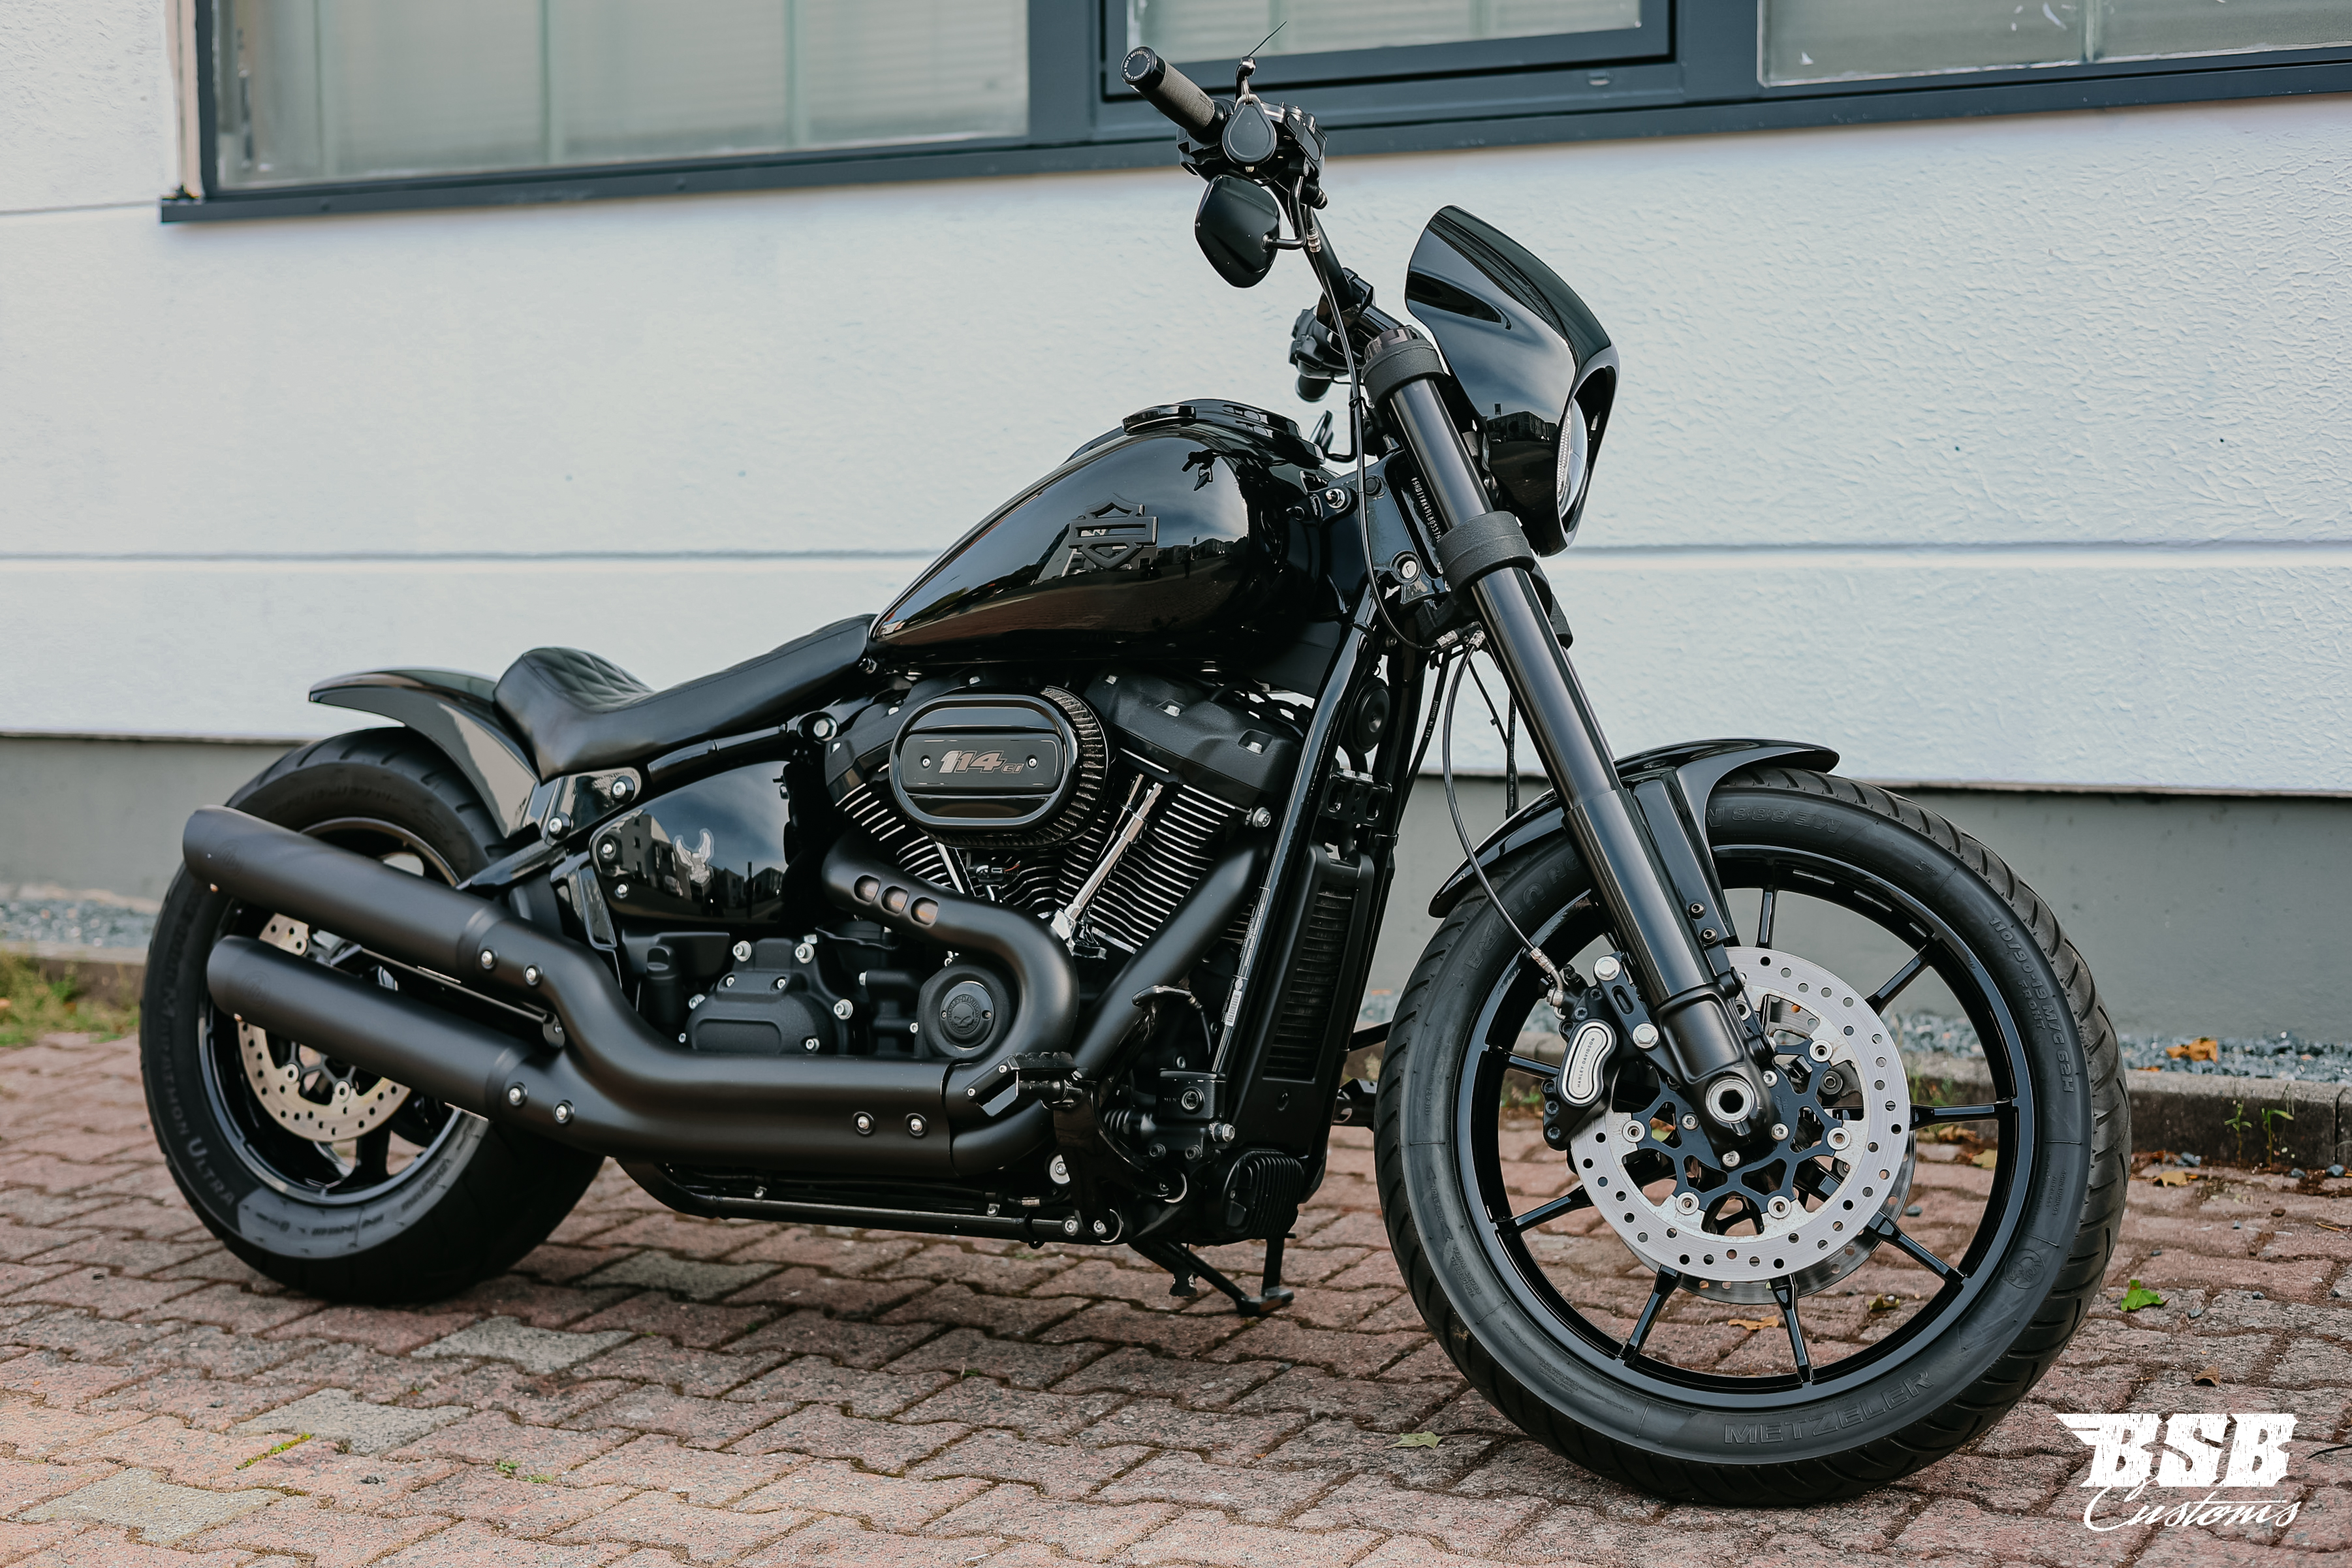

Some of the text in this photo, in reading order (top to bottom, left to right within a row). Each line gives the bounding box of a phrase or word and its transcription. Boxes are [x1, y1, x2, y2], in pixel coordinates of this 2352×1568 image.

[1989, 917, 2048, 1000] 110/90-19
[2056, 1050, 2074, 1093] 62H
[2017, 980, 2045, 1029] FRONT
[185, 1136, 236, 1206] ULTRA
[1724, 1371, 1934, 1443] METZELER
